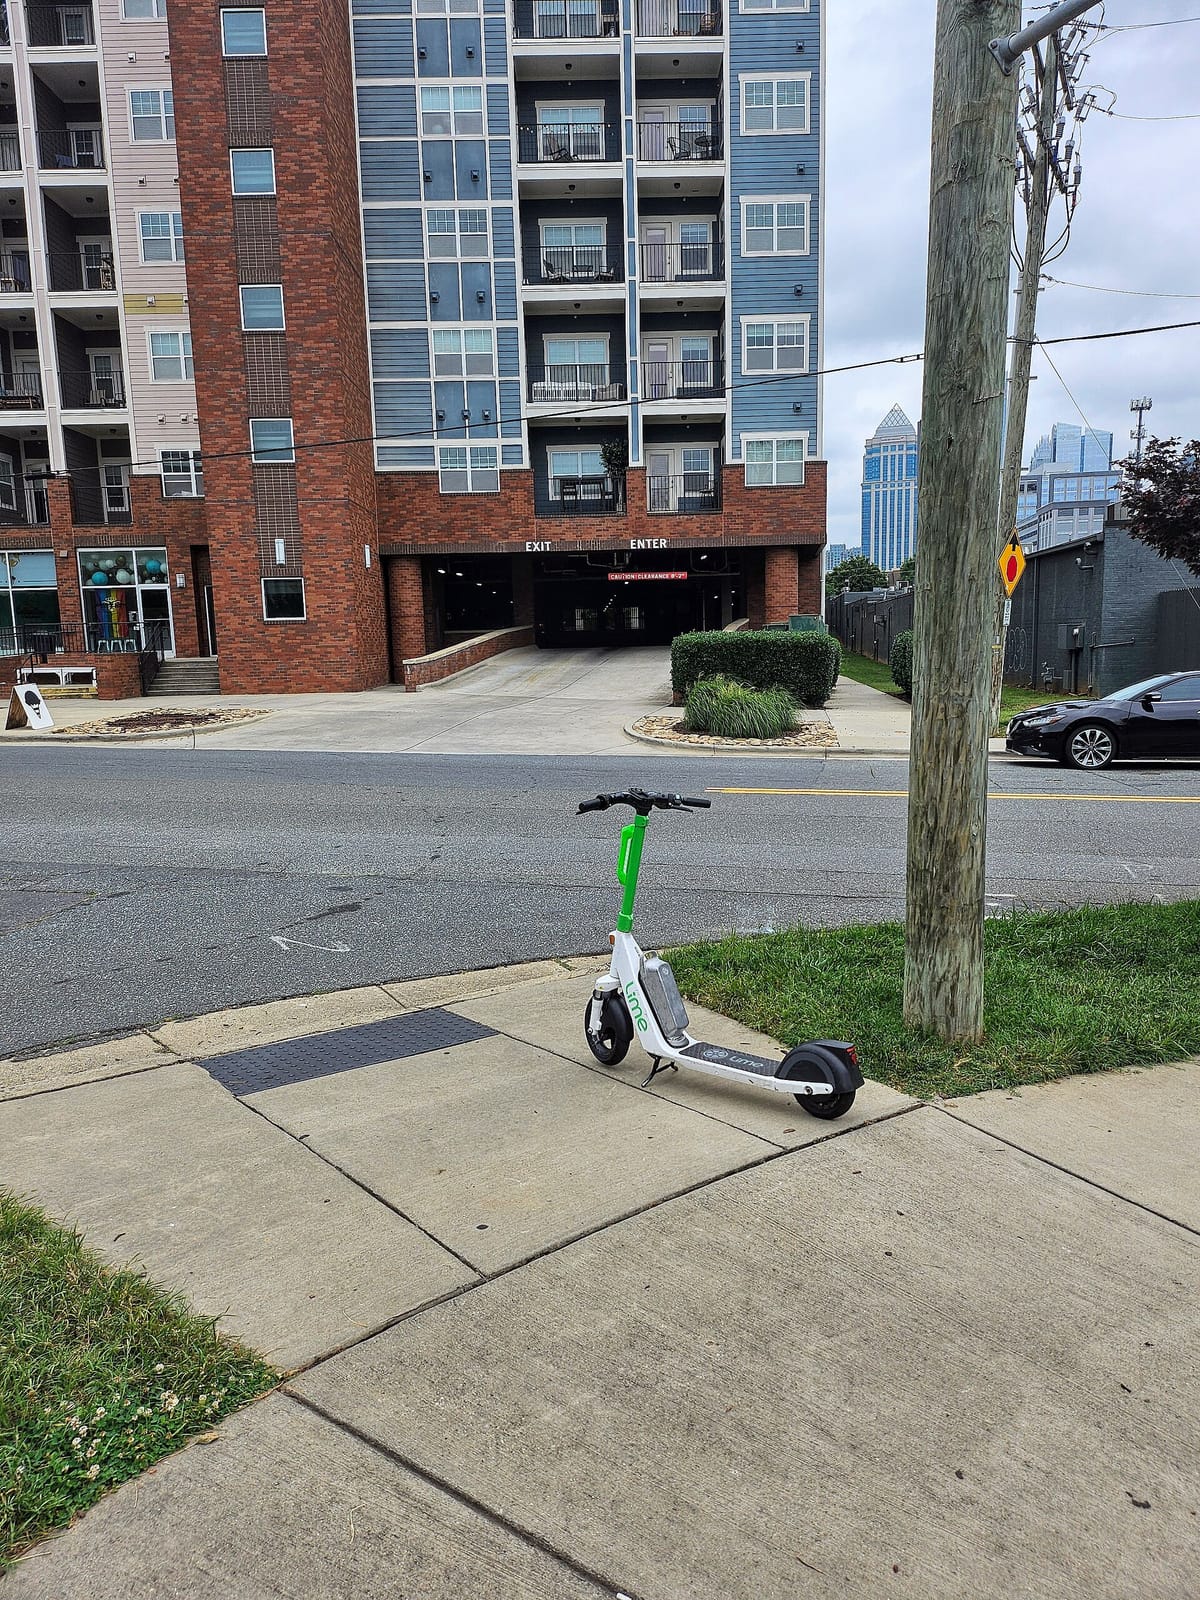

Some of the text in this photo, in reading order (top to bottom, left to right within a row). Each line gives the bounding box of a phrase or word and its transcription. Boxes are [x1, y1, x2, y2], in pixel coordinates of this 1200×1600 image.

[525, 541, 552, 552] EXIT
[630, 538, 668, 550] ENTER
[625, 980, 648, 1032] Lime
[729, 1055, 764, 1068] Lime
